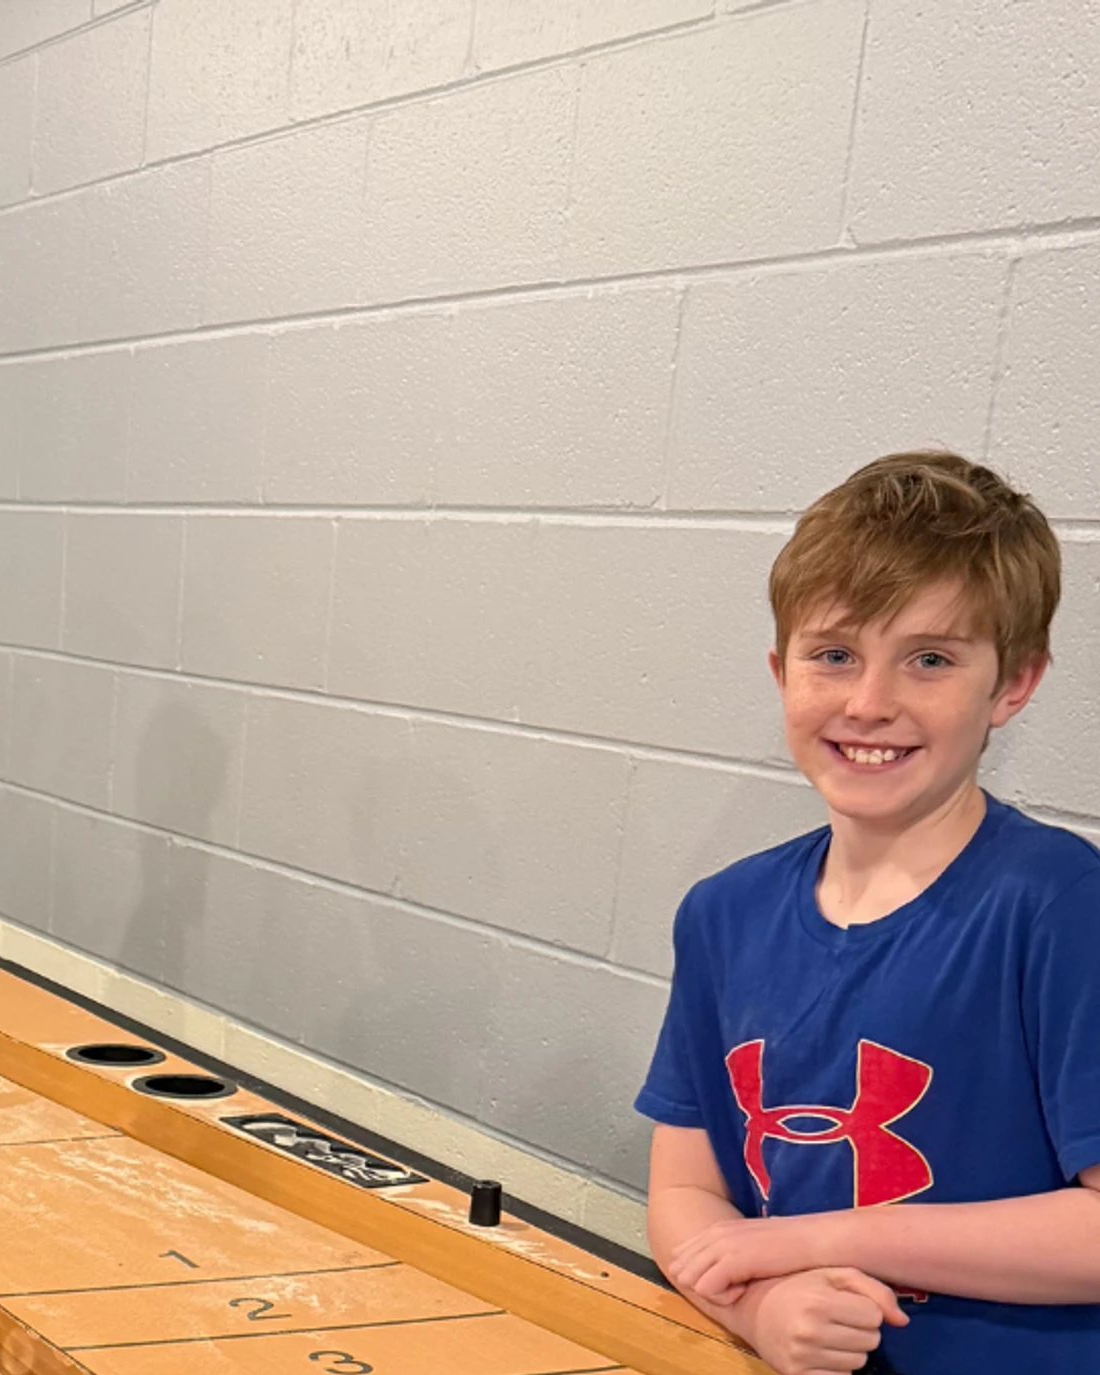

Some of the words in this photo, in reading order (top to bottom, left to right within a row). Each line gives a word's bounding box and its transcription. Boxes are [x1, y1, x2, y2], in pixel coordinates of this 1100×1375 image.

[158, 1250, 200, 1268] 1
[228, 1297, 292, 1321] 2
[308, 1350, 374, 1375] 3
